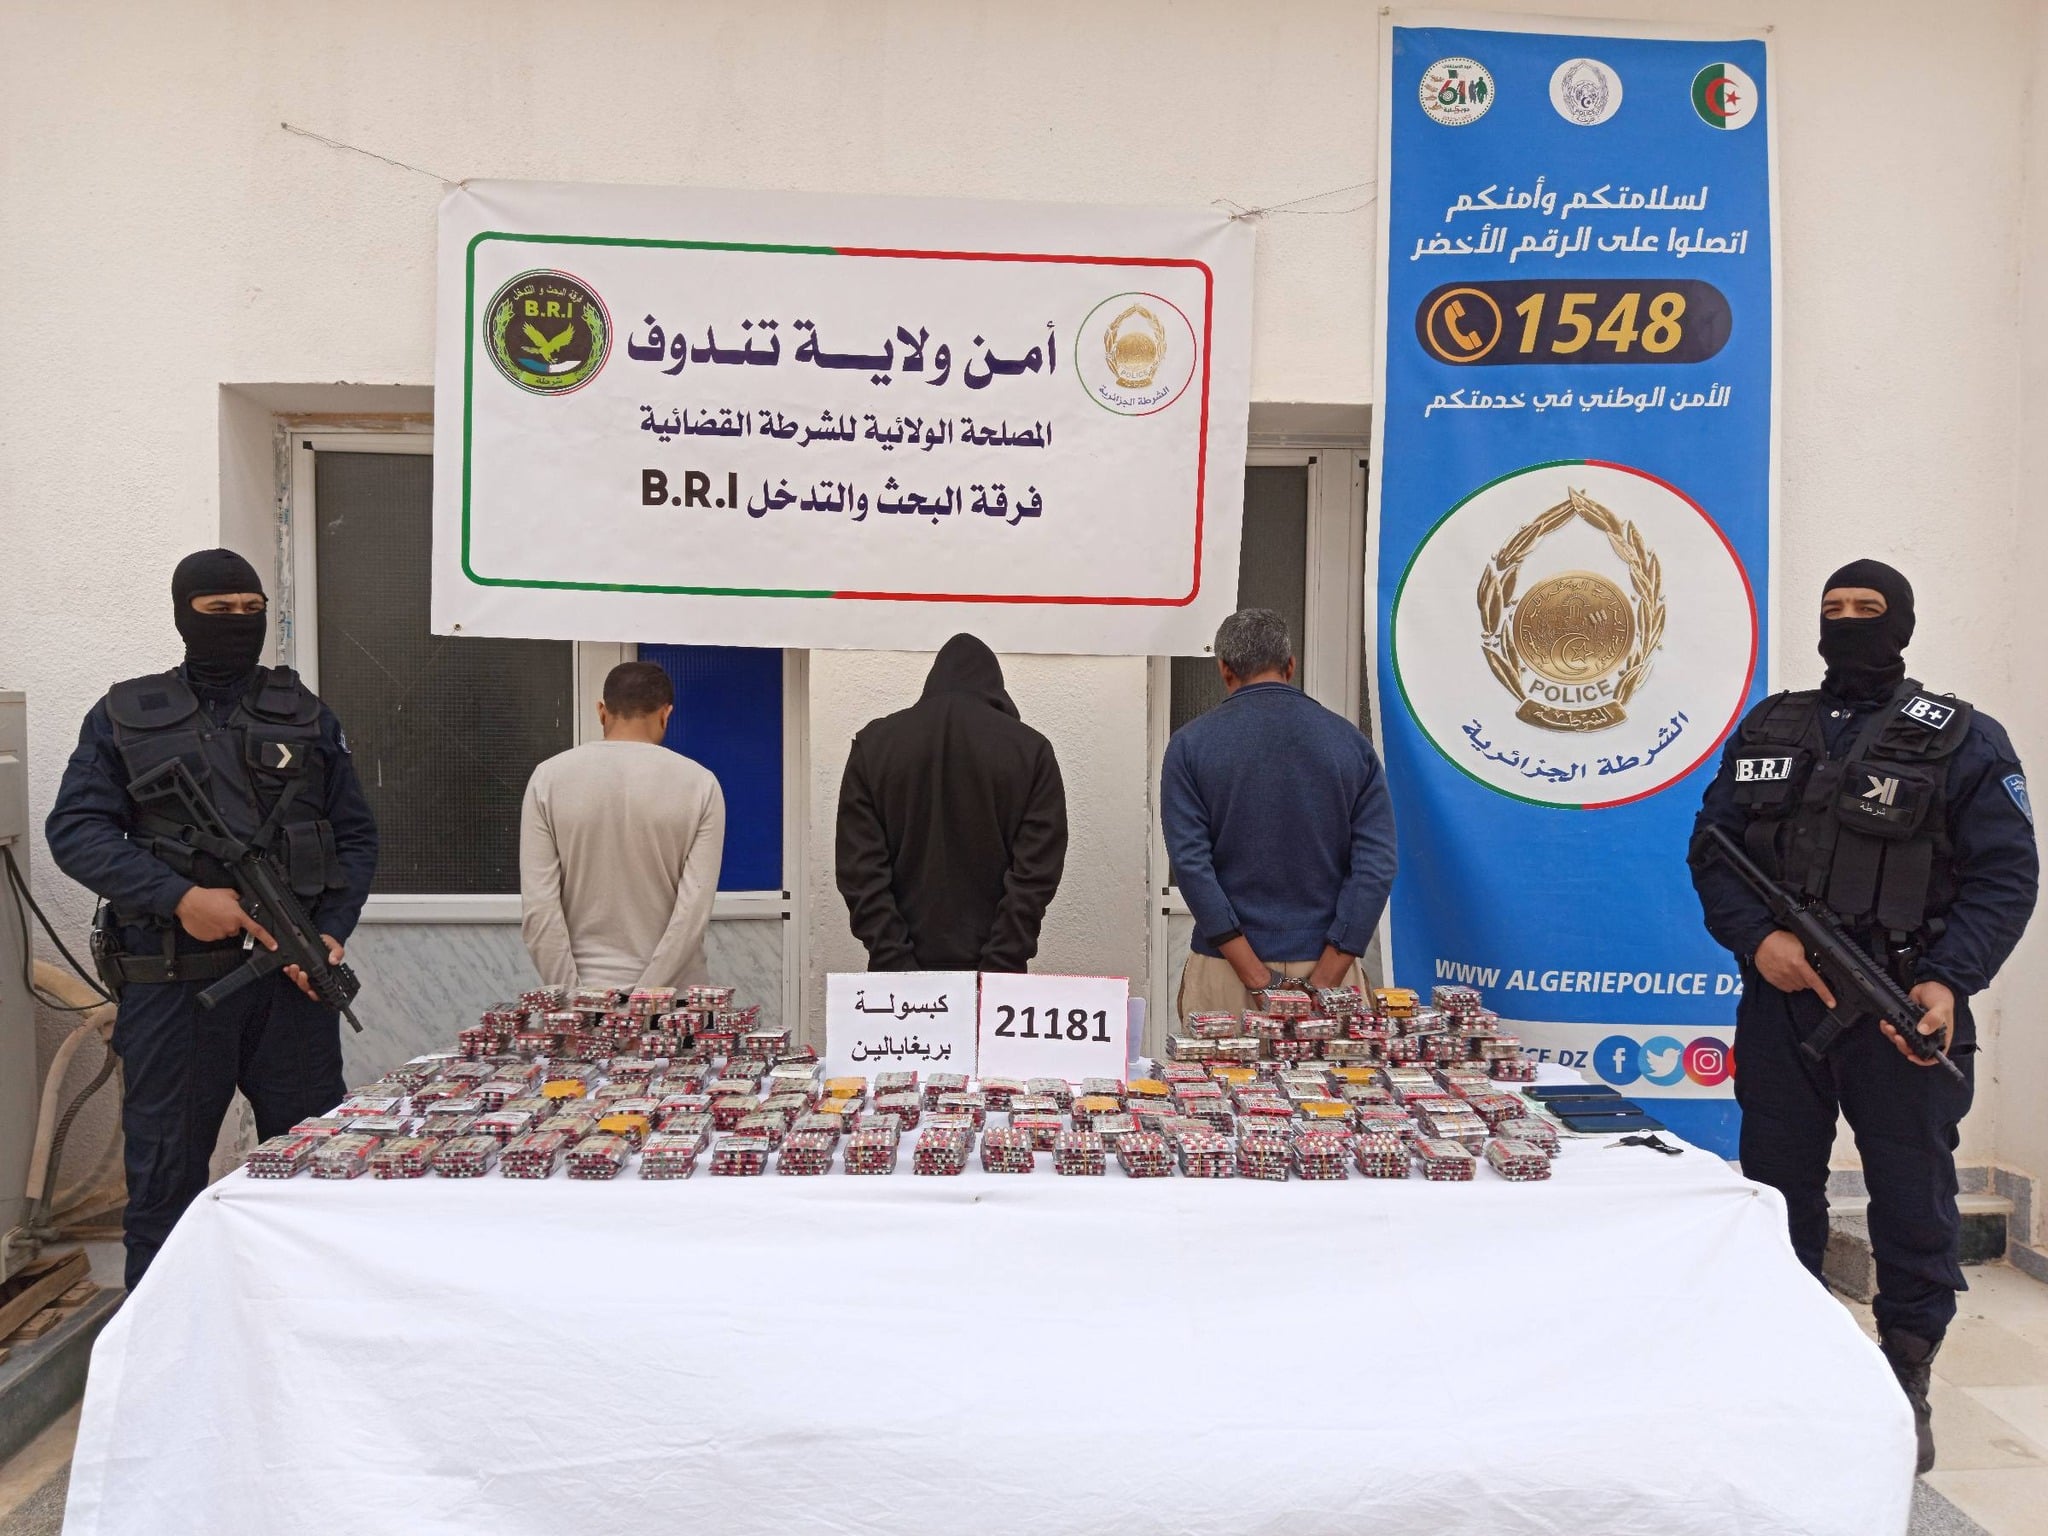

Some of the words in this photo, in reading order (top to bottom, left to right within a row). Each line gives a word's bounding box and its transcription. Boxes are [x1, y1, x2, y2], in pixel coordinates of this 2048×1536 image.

[1445, 175, 1557, 223] وأمنكم
[1560, 184, 1708, 220] لسلامتكم
[1410, 223, 1508, 261] الأخضر
[1509, 226, 1592, 264] الرقم
[1597, 226, 1659, 252] على
[1667, 226, 1748, 258] اتصلوا
[525, 300, 573, 318] B.R.I
[1515, 291, 1687, 354] 1548
[628, 314, 780, 376] تندوف
[793, 319, 951, 387] ولاية
[963, 320, 1056, 389] أمن
[1098, 384, 1135, 408] الجزائرية
[1138, 386, 1170, 406] الشرطة
[1424, 388, 1525, 418] خدمتكم
[1532, 389, 1573, 412] في
[1579, 386, 1666, 413] الوطني
[1669, 382, 1731, 411] الأمن
[639, 405, 751, 443] القضائية
[758, 409, 857, 447] للشرطة
[864, 414, 953, 451] الولائية
[960, 417, 1052, 448] المصلحة
[642, 469, 738, 509] B.R.I
[747, 478, 868, 522] والتدخل
[877, 476, 962, 525] البحث
[970, 483, 1043, 526] فرقة
[1528, 679, 1613, 703] POLICE
[1909, 699, 1943, 722] B+
[1462, 718, 1587, 783] الجزائرية
[1597, 710, 1690, 776] الشرطة
[1739, 759, 1790, 780] B.R.I
[1860, 801, 1886, 816] شرطة
[1435, 958, 1501, 988] WWW
[1505, 968, 1707, 996] ALGERIEPOLICE
[854, 989, 949, 1020] كبسولة
[994, 1005, 1111, 1043] 21181
[851, 1033, 951, 1061] بريغابالين
[1558, 1049, 1589, 1069] DZ
